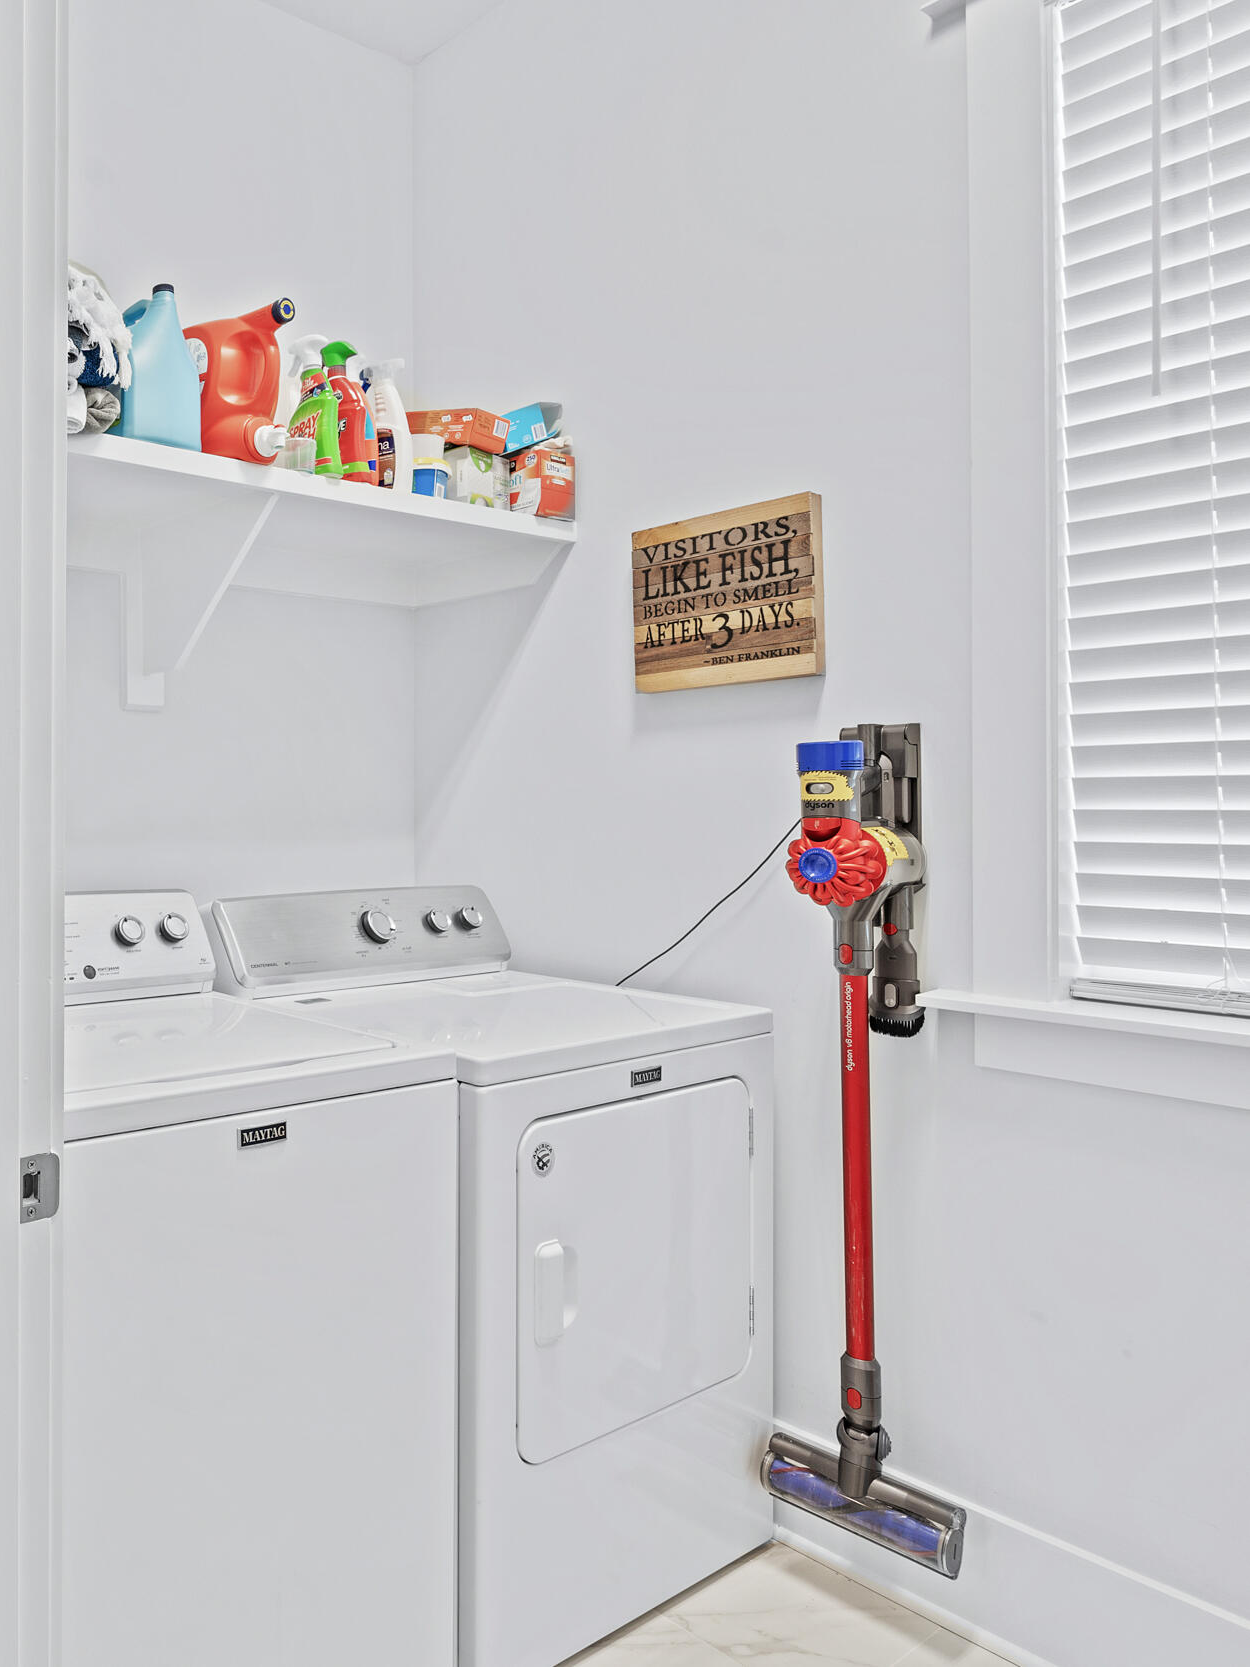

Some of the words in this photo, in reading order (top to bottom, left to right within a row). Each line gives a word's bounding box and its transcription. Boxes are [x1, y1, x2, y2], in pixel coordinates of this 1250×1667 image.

[289, 409, 322, 439] SPRAY
[641, 516, 798, 564] VISITORS,
[642, 557, 712, 601] LIKE
[718, 539, 799, 587] FISH,
[643, 599, 696, 620] BEGIN
[700, 591, 727, 610] TO
[733, 579, 800, 608] SMELL
[644, 617, 706, 649] AFTER
[710, 613, 734, 649] 3
[739, 601, 800, 635] DAYS.
[738, 646, 801, 663] FRANKLIN
[805, 801, 835, 811] dyson
[844, 981, 853, 1000] origin
[844, 1000, 853, 1038] motorhead
[845, 1049, 855, 1071] dyson
[634, 1069, 661, 1083] MAYTAG
[242, 1125, 286, 1144] MAYTAG
